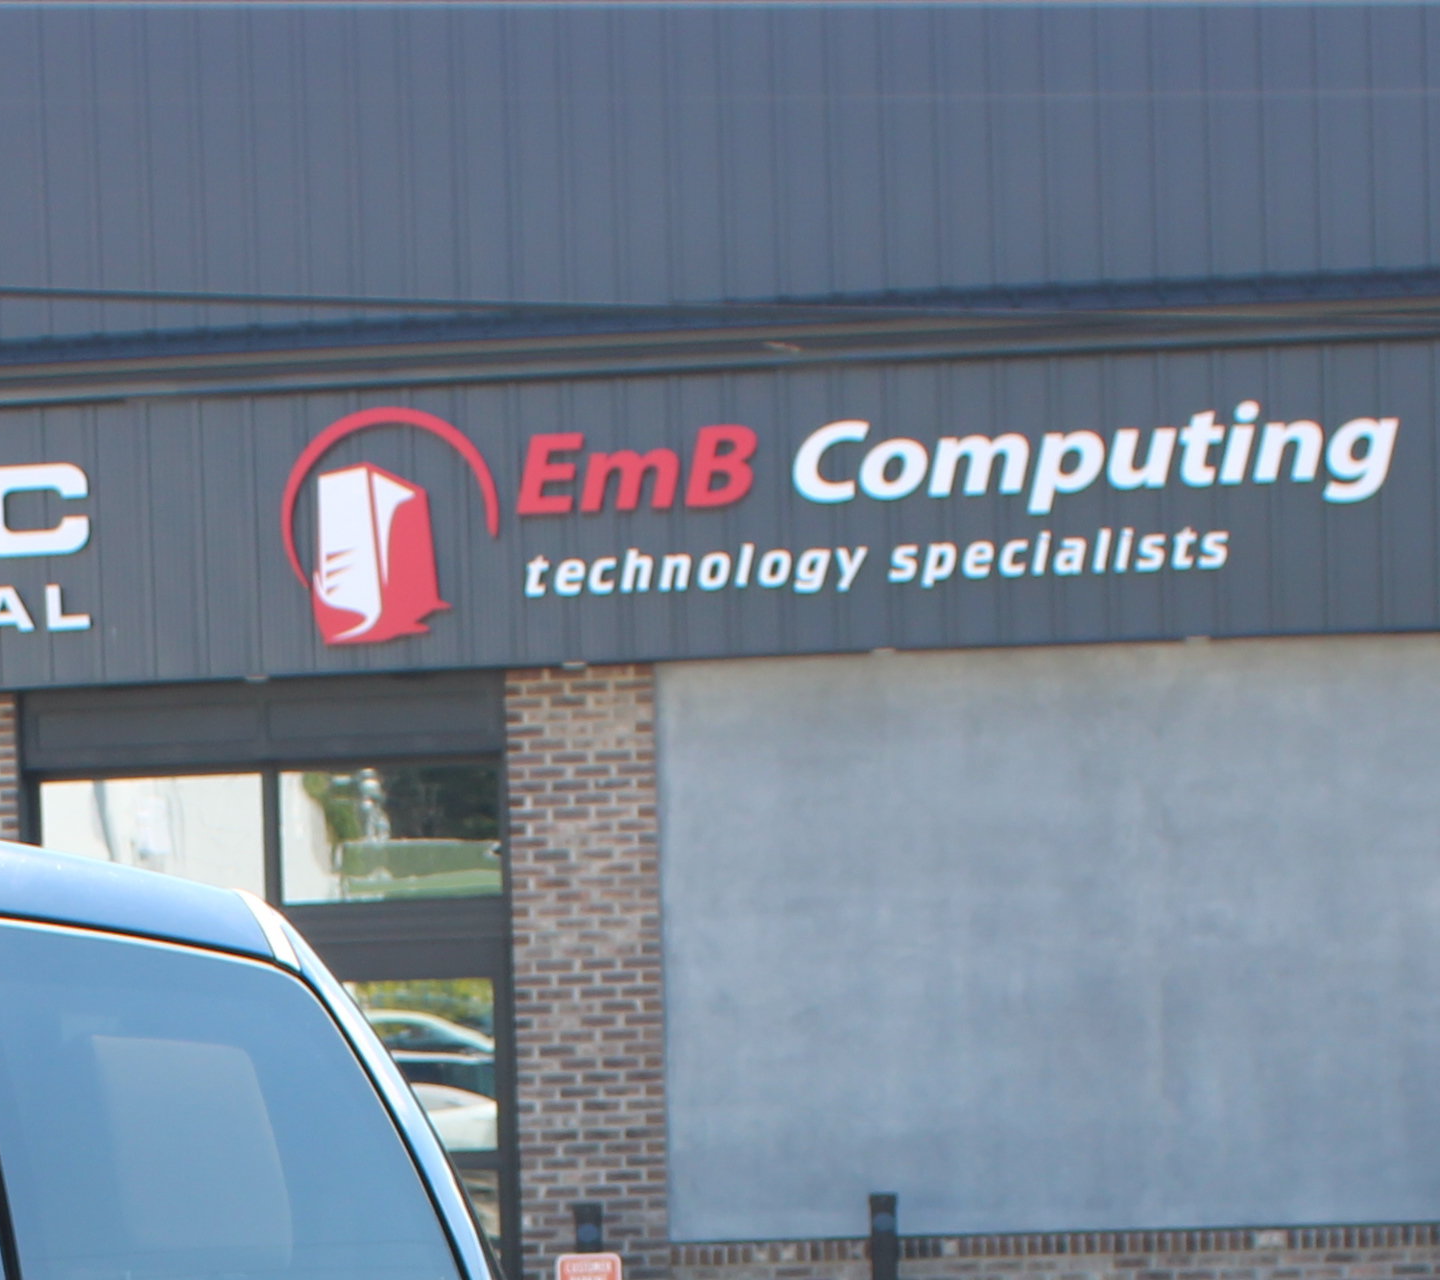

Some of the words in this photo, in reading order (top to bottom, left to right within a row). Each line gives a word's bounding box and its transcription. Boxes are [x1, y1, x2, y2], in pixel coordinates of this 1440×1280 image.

[517, 423, 758, 517] EmB
[793, 401, 1399, 514] Computing
[525, 539, 868, 598] technology
[889, 525, 1230, 587] specialists
